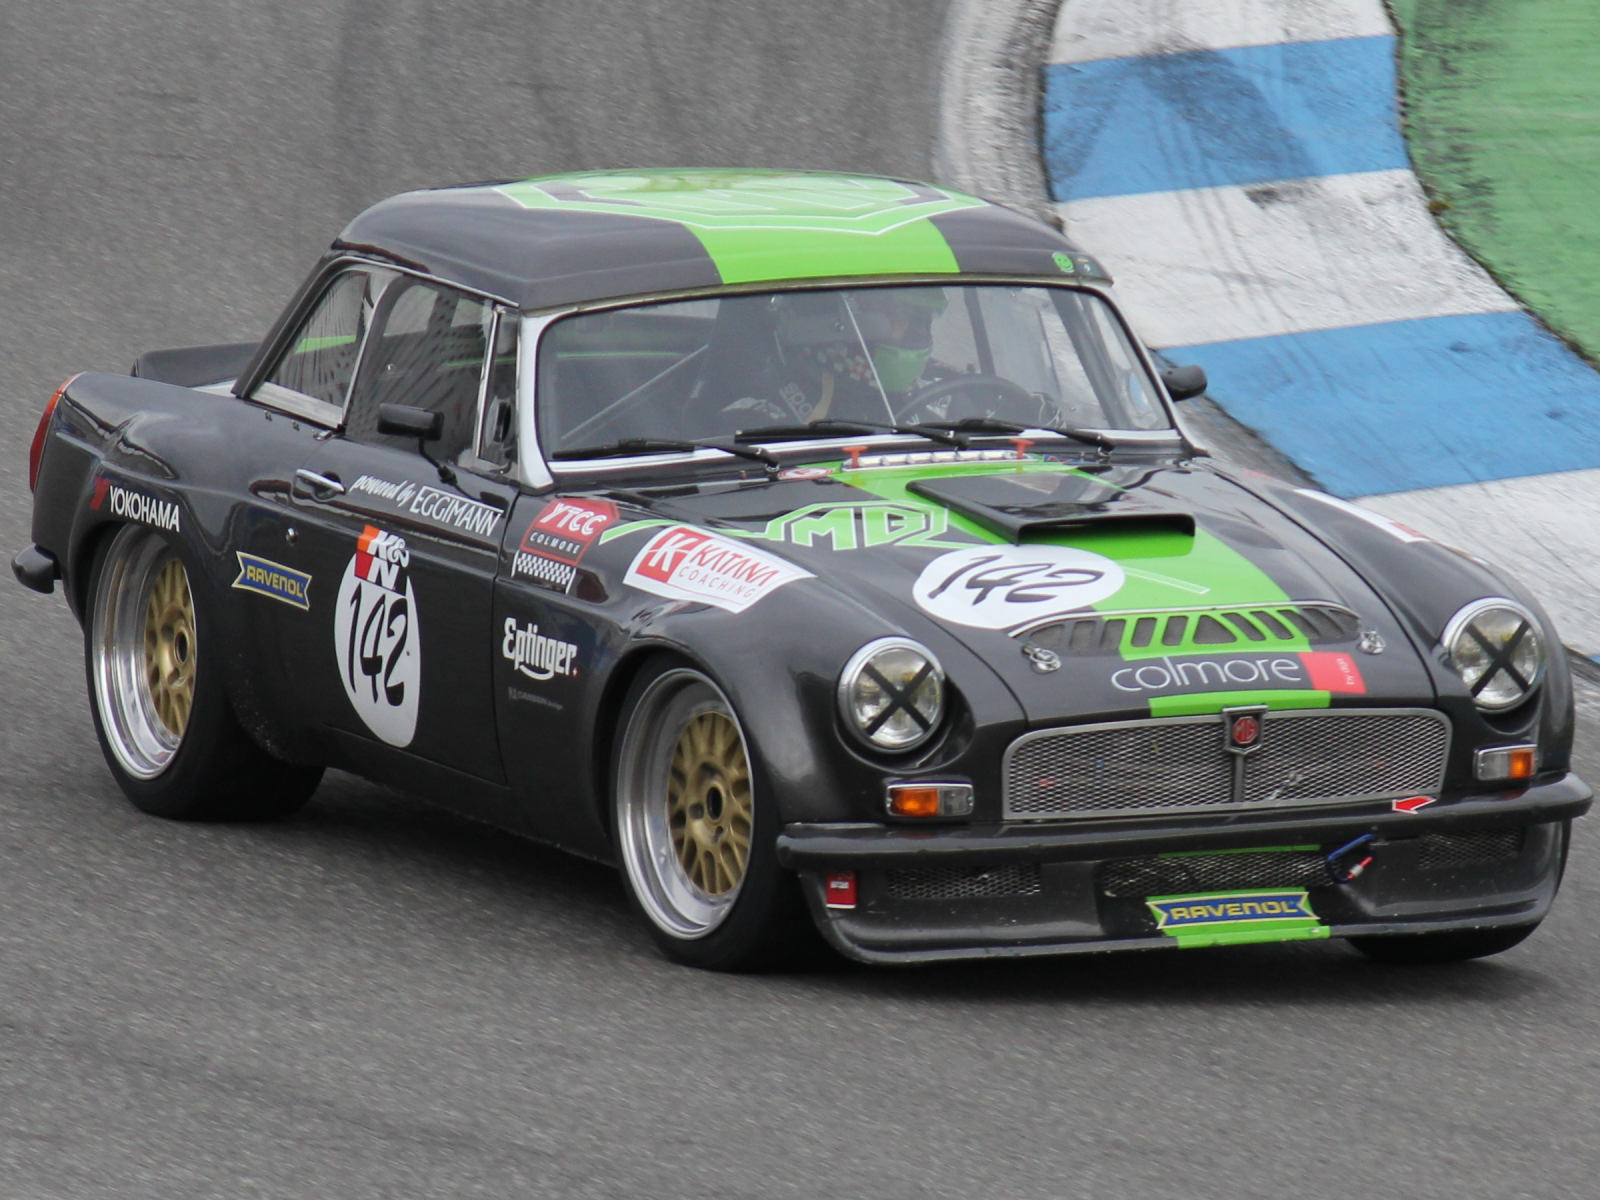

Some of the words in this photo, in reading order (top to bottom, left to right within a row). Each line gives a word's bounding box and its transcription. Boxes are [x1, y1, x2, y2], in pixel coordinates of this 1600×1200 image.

[109, 485, 180, 533] YOKOHAMA
[348, 475, 408, 499] powered
[396, 482, 416, 507] by
[409, 486, 504, 537] EGGIMANN
[539, 502, 608, 536] YTCC
[529, 531, 581, 555] COLMORE
[790, 505, 926, 551] MG
[246, 564, 304, 598] RAVENOL
[678, 565, 758, 598] COACHING
[689, 543, 780, 588] KATANA
[927, 553, 1105, 606] 142
[348, 581, 409, 707] 142
[1111, 655, 1302, 692] colmore
[1233, 717, 1258, 742] MG
[1170, 901, 1299, 920] RAVENOL
